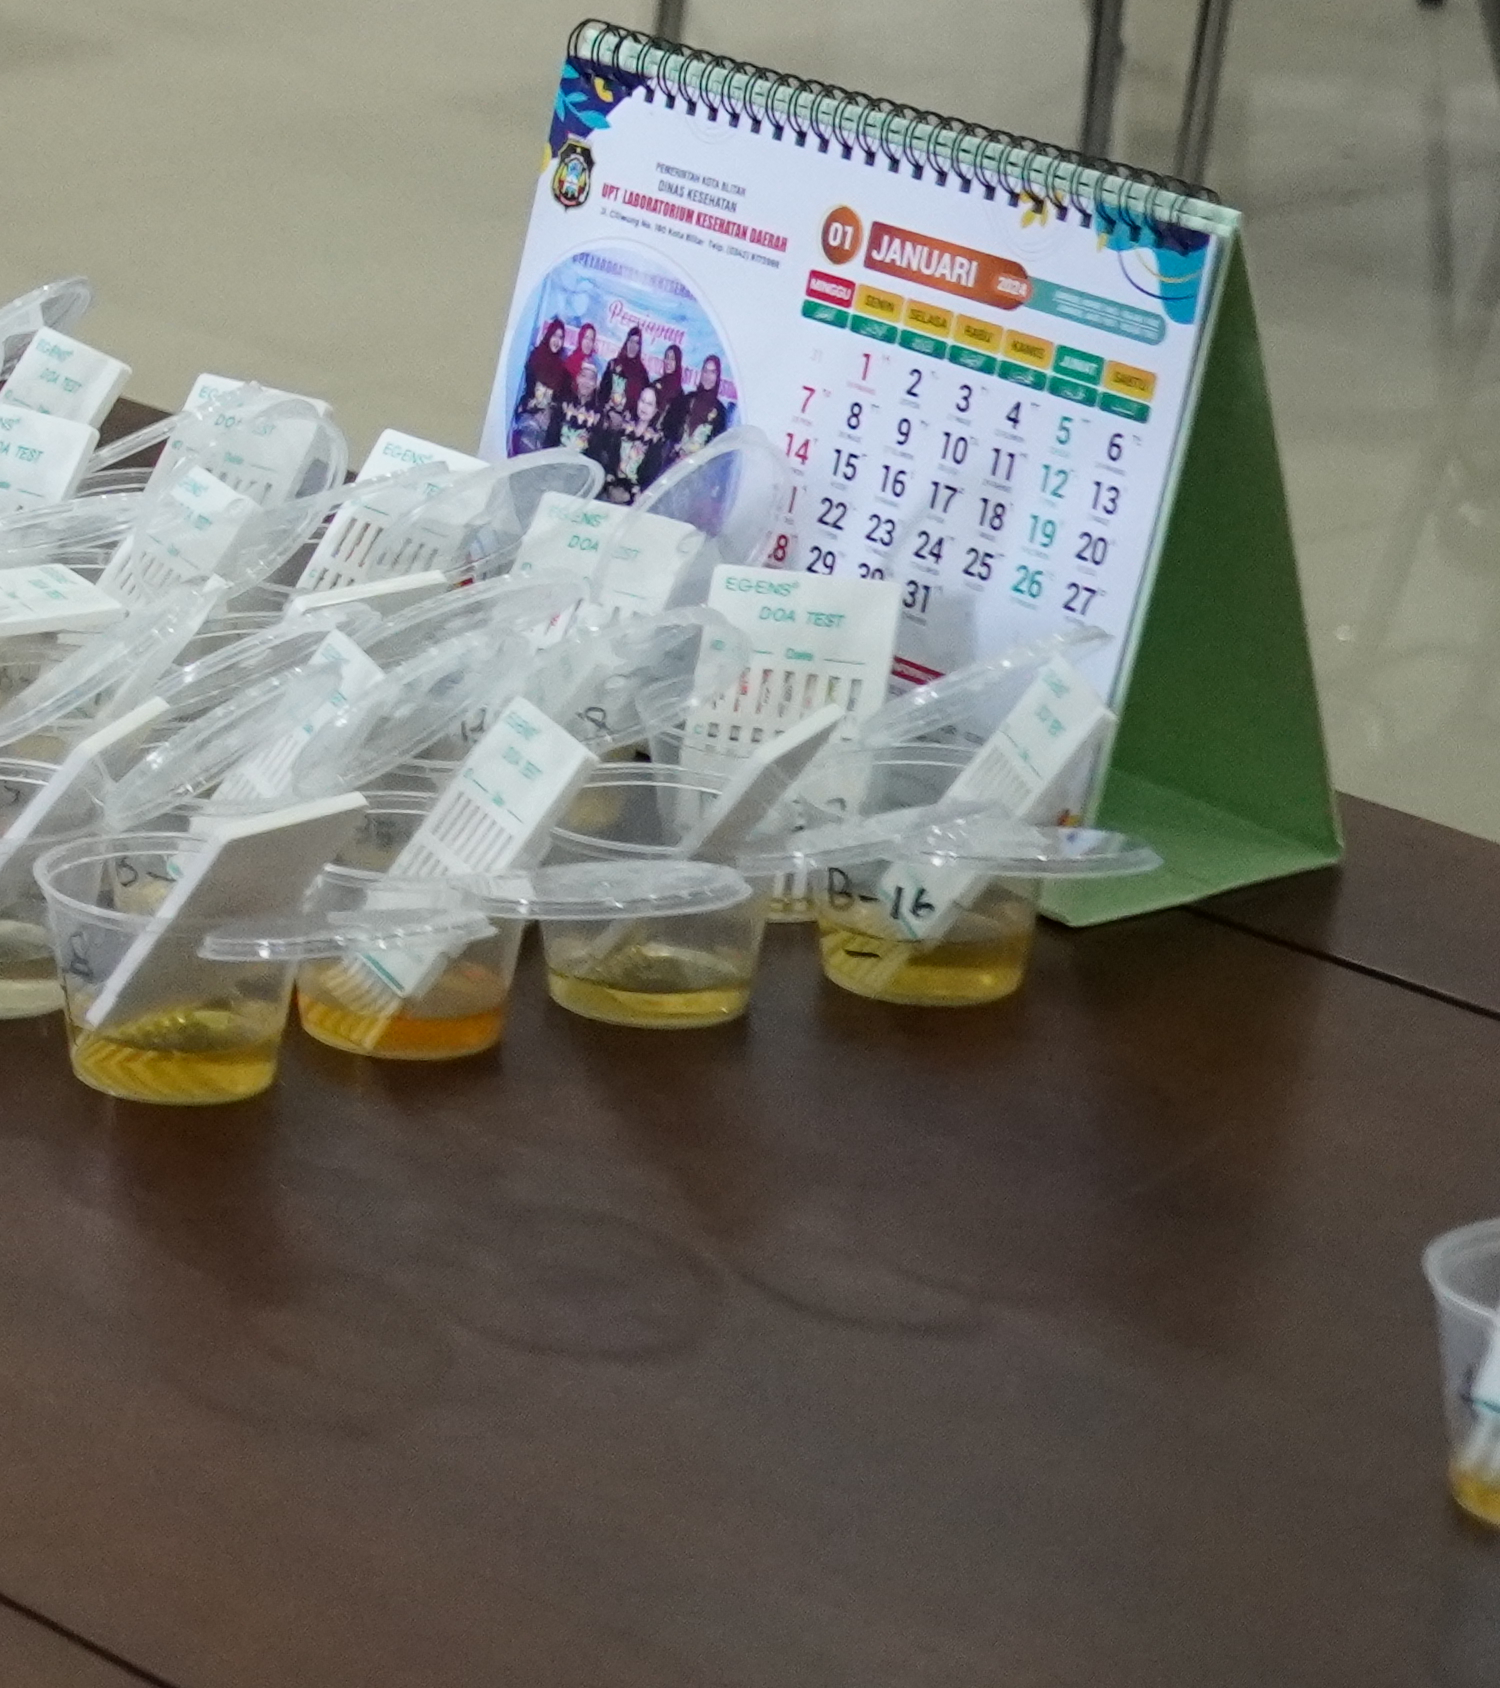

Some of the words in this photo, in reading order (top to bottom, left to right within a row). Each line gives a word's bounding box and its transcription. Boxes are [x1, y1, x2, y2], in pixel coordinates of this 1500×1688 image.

[601, 182, 621, 202] UPT
[622, 189, 695, 225] LABORATORIUM
[695, 212, 749, 241] KESEHATAN
[749, 228, 789, 252] DAERAH
[657, 179, 685, 199] DINAS
[687, 188, 738, 213] KESEHATAN
[828, 222, 854, 250] 01
[871, 234, 979, 288] JANUARI
[997, 276, 1028, 298] 2024
[809, 278, 852, 300] MINGGU
[865, 294, 895, 312] SENIN
[908, 308, 948, 328] SELASA
[862, 353, 872, 381] 1
[906, 368, 922, 397] 2
[955, 384, 973, 413] 3
[1006, 401, 1022, 430] 4
[1056, 416, 1073, 445] 5
[1107, 433, 1124, 462] 6
[15, 445, 44, 462] TEST
[801, 385, 816, 414] 7
[847, 402, 863, 430] 8
[896, 418, 911, 446] 9
[940, 431, 969, 465] 10
[990, 447, 1016, 482] 11
[1041, 464, 1069, 499] 12
[1091, 481, 1121, 516] 13
[785, 432, 811, 466] 14
[832, 448, 860, 482] 15
[880, 464, 907, 498] 16
[928, 481, 959, 514] 17
[978, 497, 1007, 532] 18
[1028, 514, 1057, 548] 19
[1075, 532, 1108, 566] 20
[568, 534, 599, 552] DOA
[768, 534, 789, 563] 8
[806, 546, 837, 576] 29
[902, 579, 932, 614] 31
[817, 497, 849, 532] 22
[864, 514, 896, 548] 23
[913, 530, 945, 565] 24
[962, 547, 995, 582] 25
[1011, 564, 1044, 599] 26
[1062, 582, 1098, 615] 27
[759, 606, 796, 622] DOA
[806, 611, 845, 628] TEST
